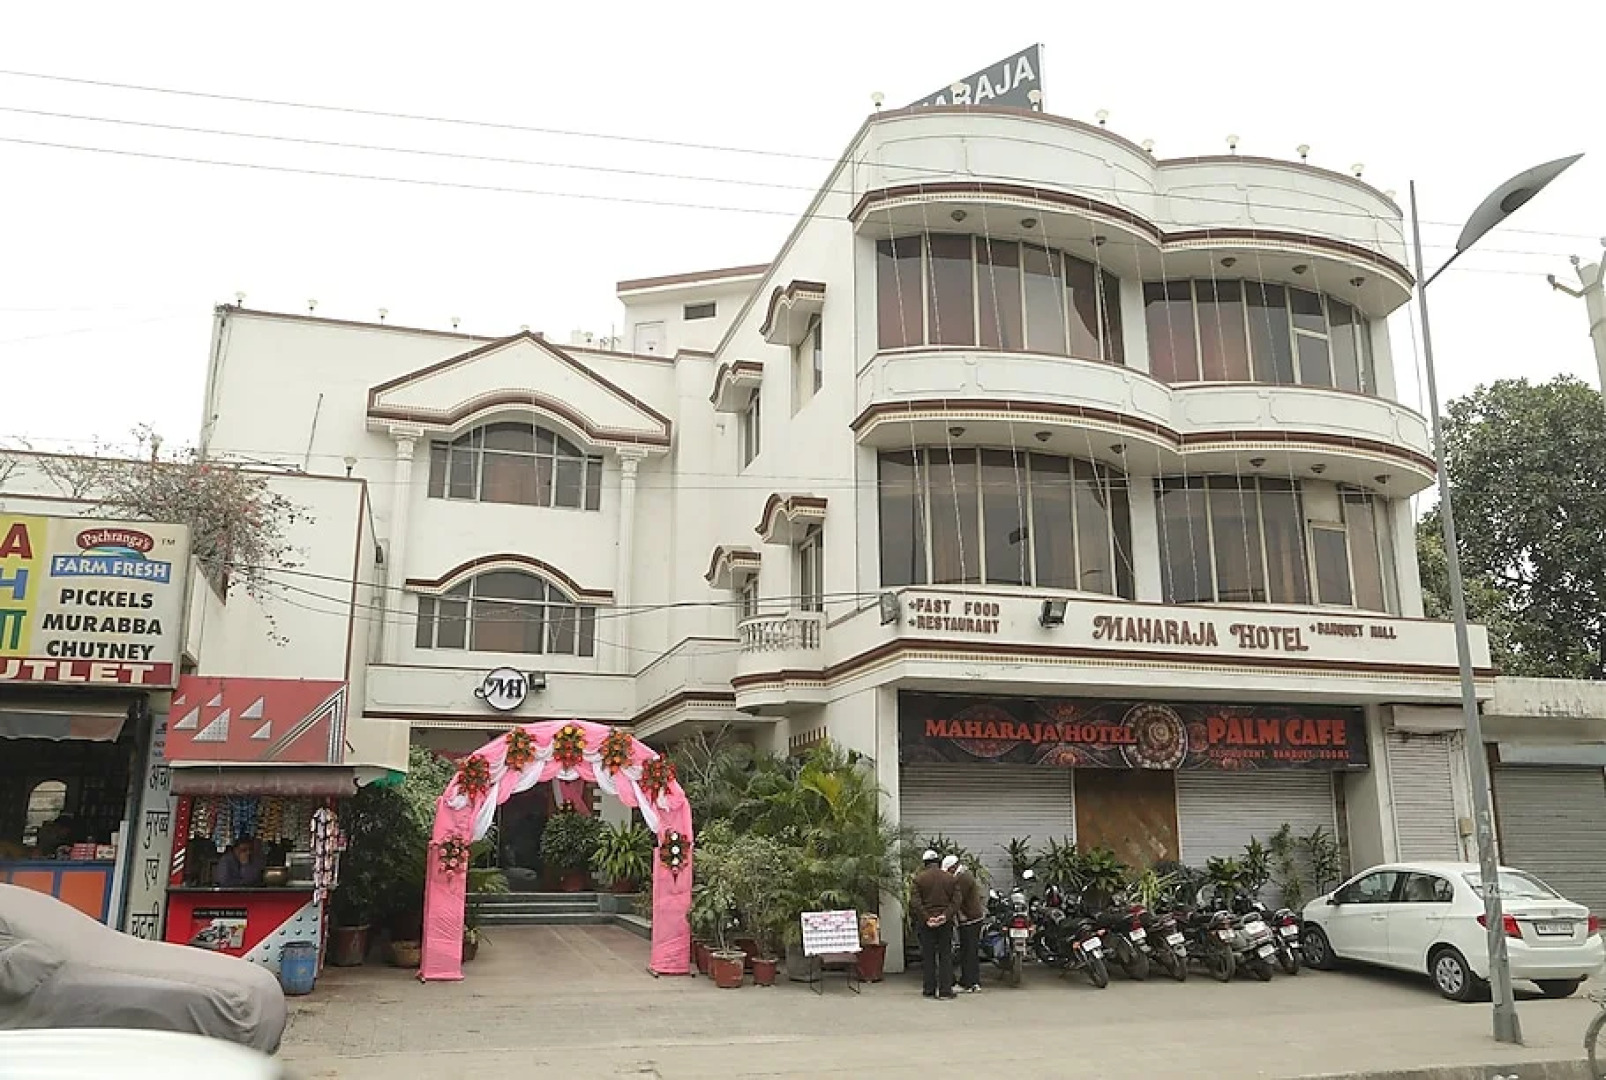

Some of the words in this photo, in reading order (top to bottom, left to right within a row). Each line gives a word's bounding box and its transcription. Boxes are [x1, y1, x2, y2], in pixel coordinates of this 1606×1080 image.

[82, 530, 151, 550] Pachranga's
[55, 557, 108, 575] FARM
[112, 562, 167, 579] FRESH
[60, 589, 153, 609] PICKELS
[916, 598, 951, 614] FAST
[964, 602, 999, 617] FOOD
[42, 614, 162, 635] MURABBA
[917, 616, 999, 634] RESTAURANT
[1092, 616, 1218, 646] MAHARAJA
[1230, 623, 1309, 651] HOTEL
[46, 640, 155, 660] CHUTNEY
[925, 720, 1059, 744] MAHARAJA
[1066, 725, 1138, 743] HOTEL
[1206, 718, 1280, 744] PALM
[1285, 719, 1346, 746] CAFE
